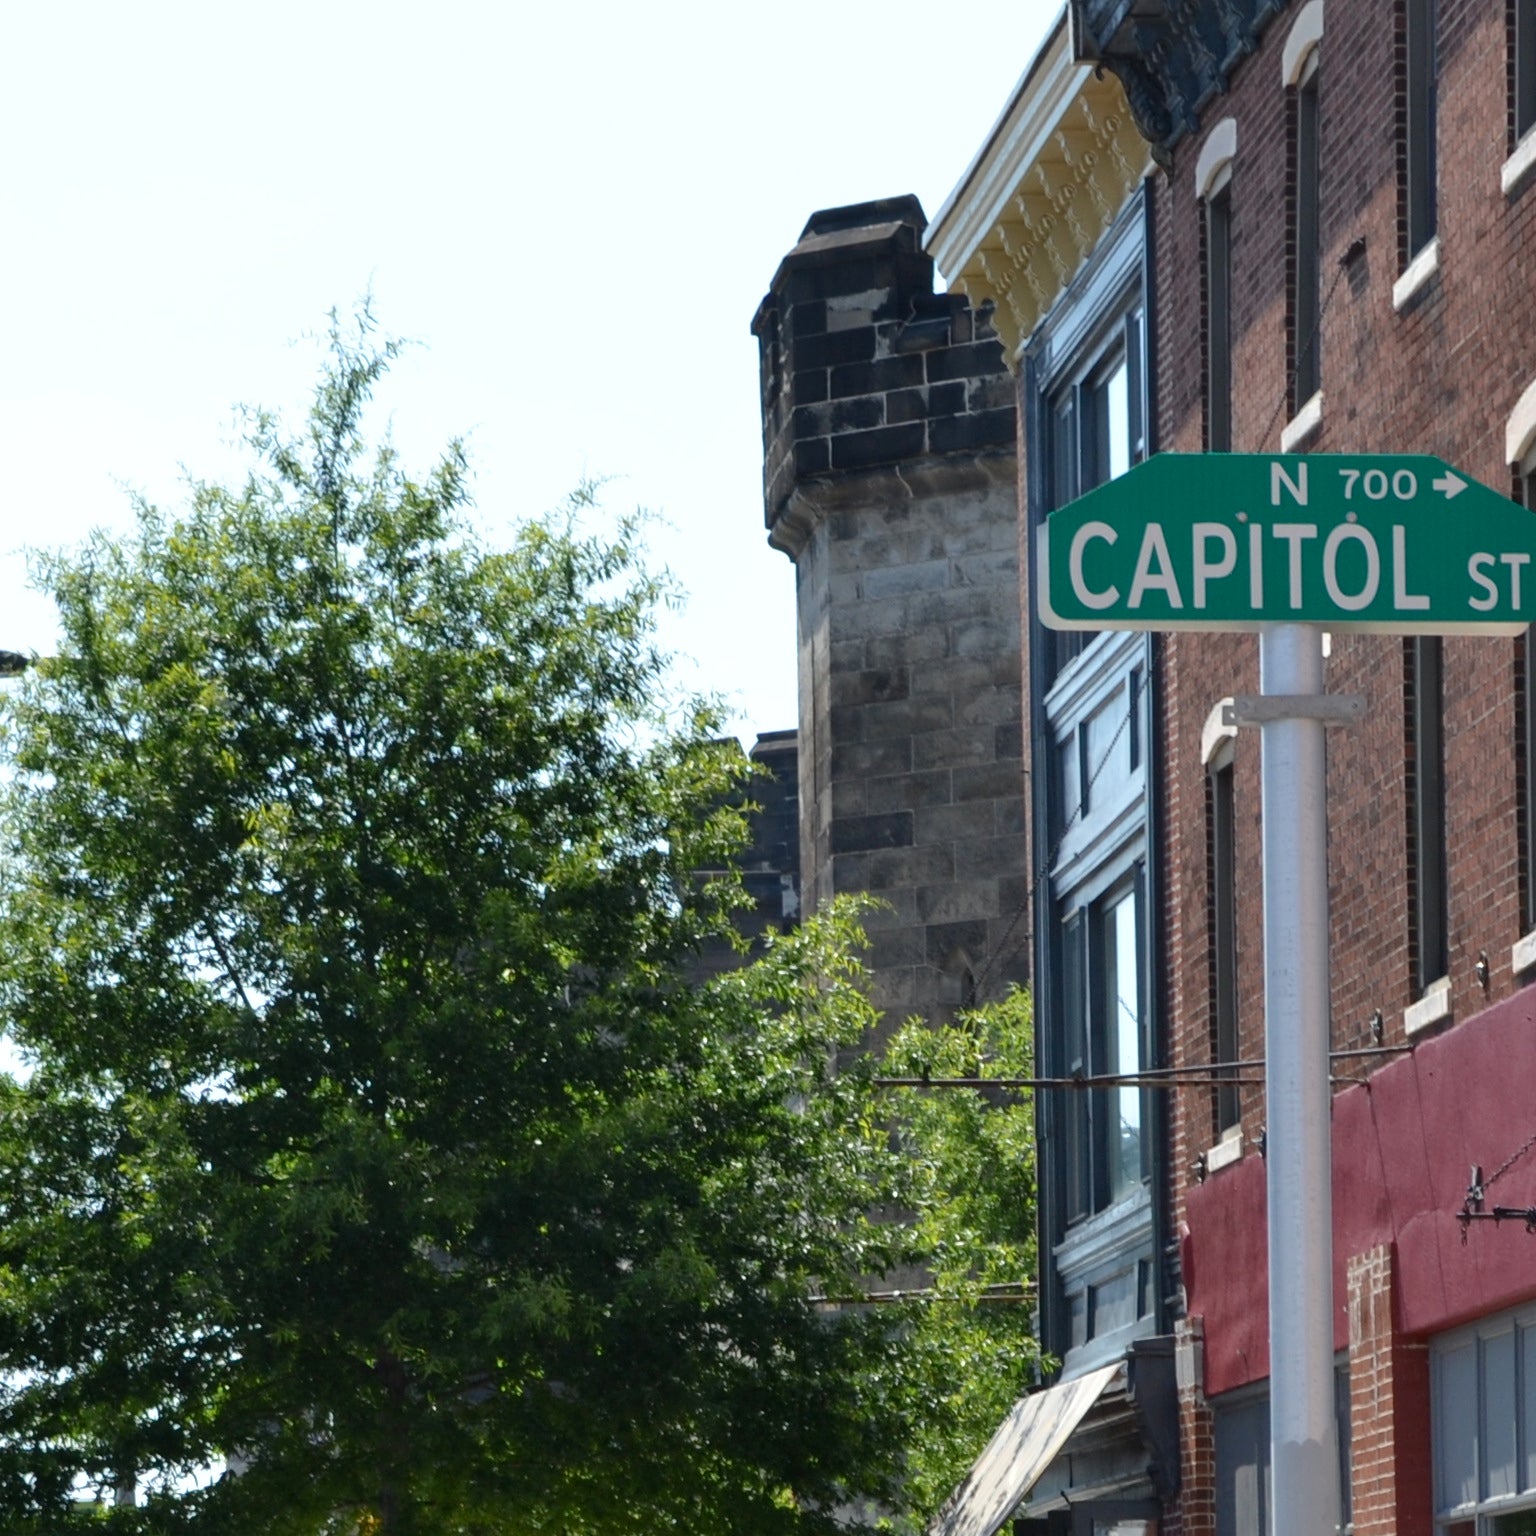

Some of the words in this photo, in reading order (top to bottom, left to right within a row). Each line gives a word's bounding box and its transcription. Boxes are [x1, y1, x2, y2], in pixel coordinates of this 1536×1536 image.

[1270, 462, 1309, 506] N
[1338, 469, 1418, 500] 700
[1068, 521, 1431, 611] CAPITOL
[1467, 553, 1531, 611] ST
